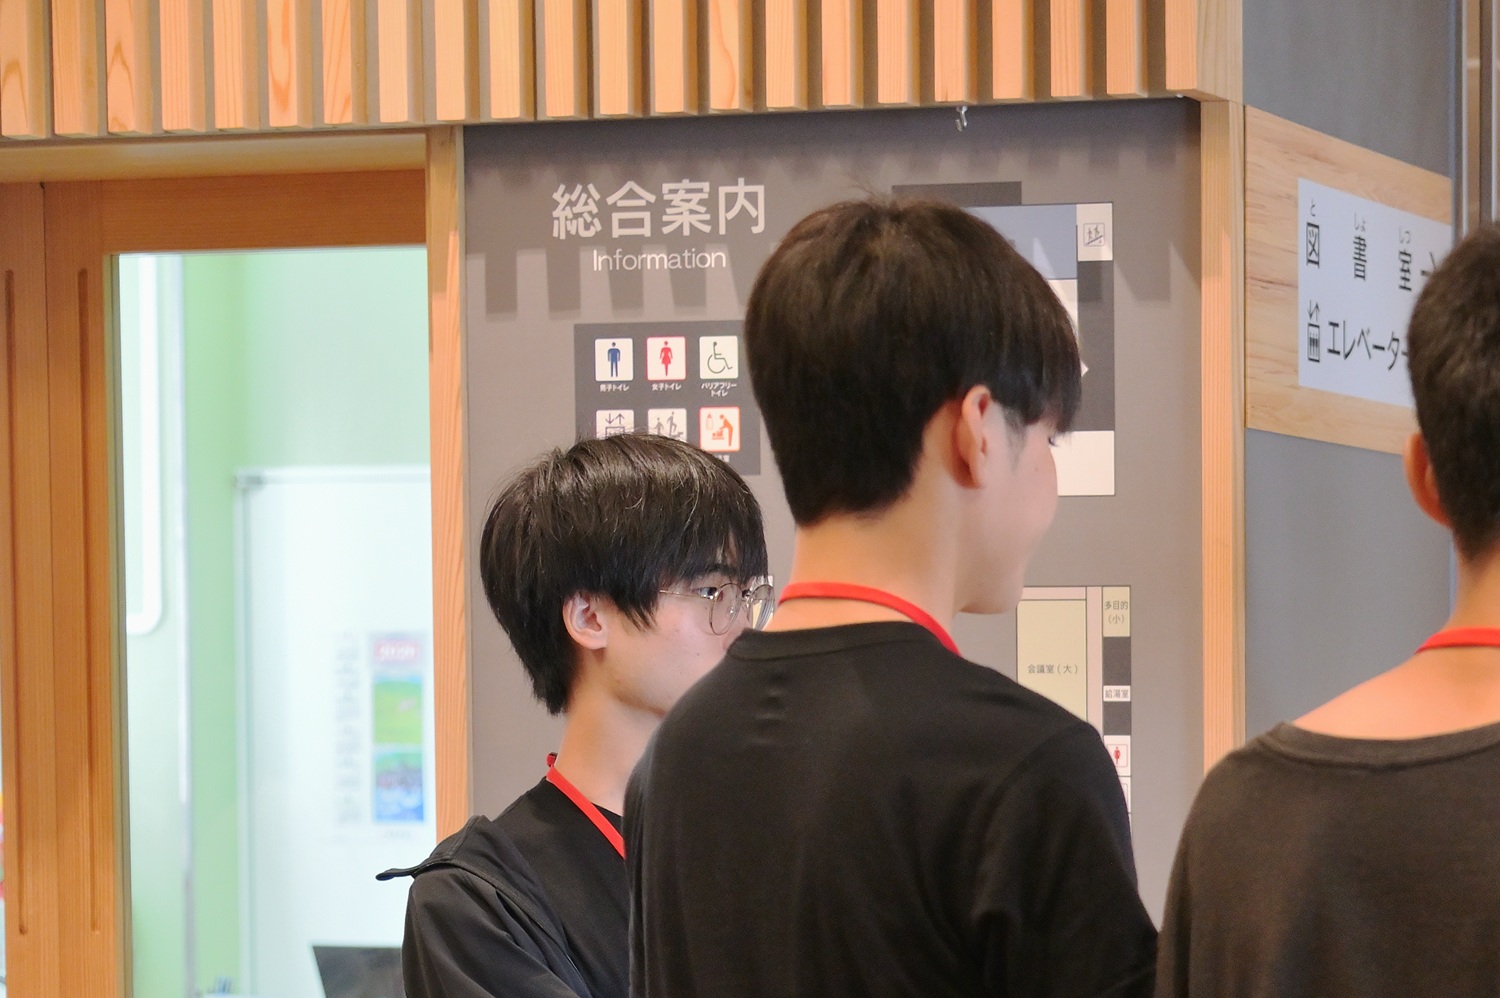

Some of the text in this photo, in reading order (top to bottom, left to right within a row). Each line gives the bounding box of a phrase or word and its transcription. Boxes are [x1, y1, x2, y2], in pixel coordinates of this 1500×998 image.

[551, 178, 767, 239] 総合案内
[592, 247, 727, 272] Information
[599, 382, 630, 392] 男子トイレ
[651, 381, 682, 391] 女子トイレ
[700, 381, 738, 390] バリアフリー
[710, 388, 729, 397] トイレ
[1104, 600, 1129, 611] 多目的
[1027, 663, 1078, 675] 会議室（大）
[1104, 688, 1130, 699] 給湯室
